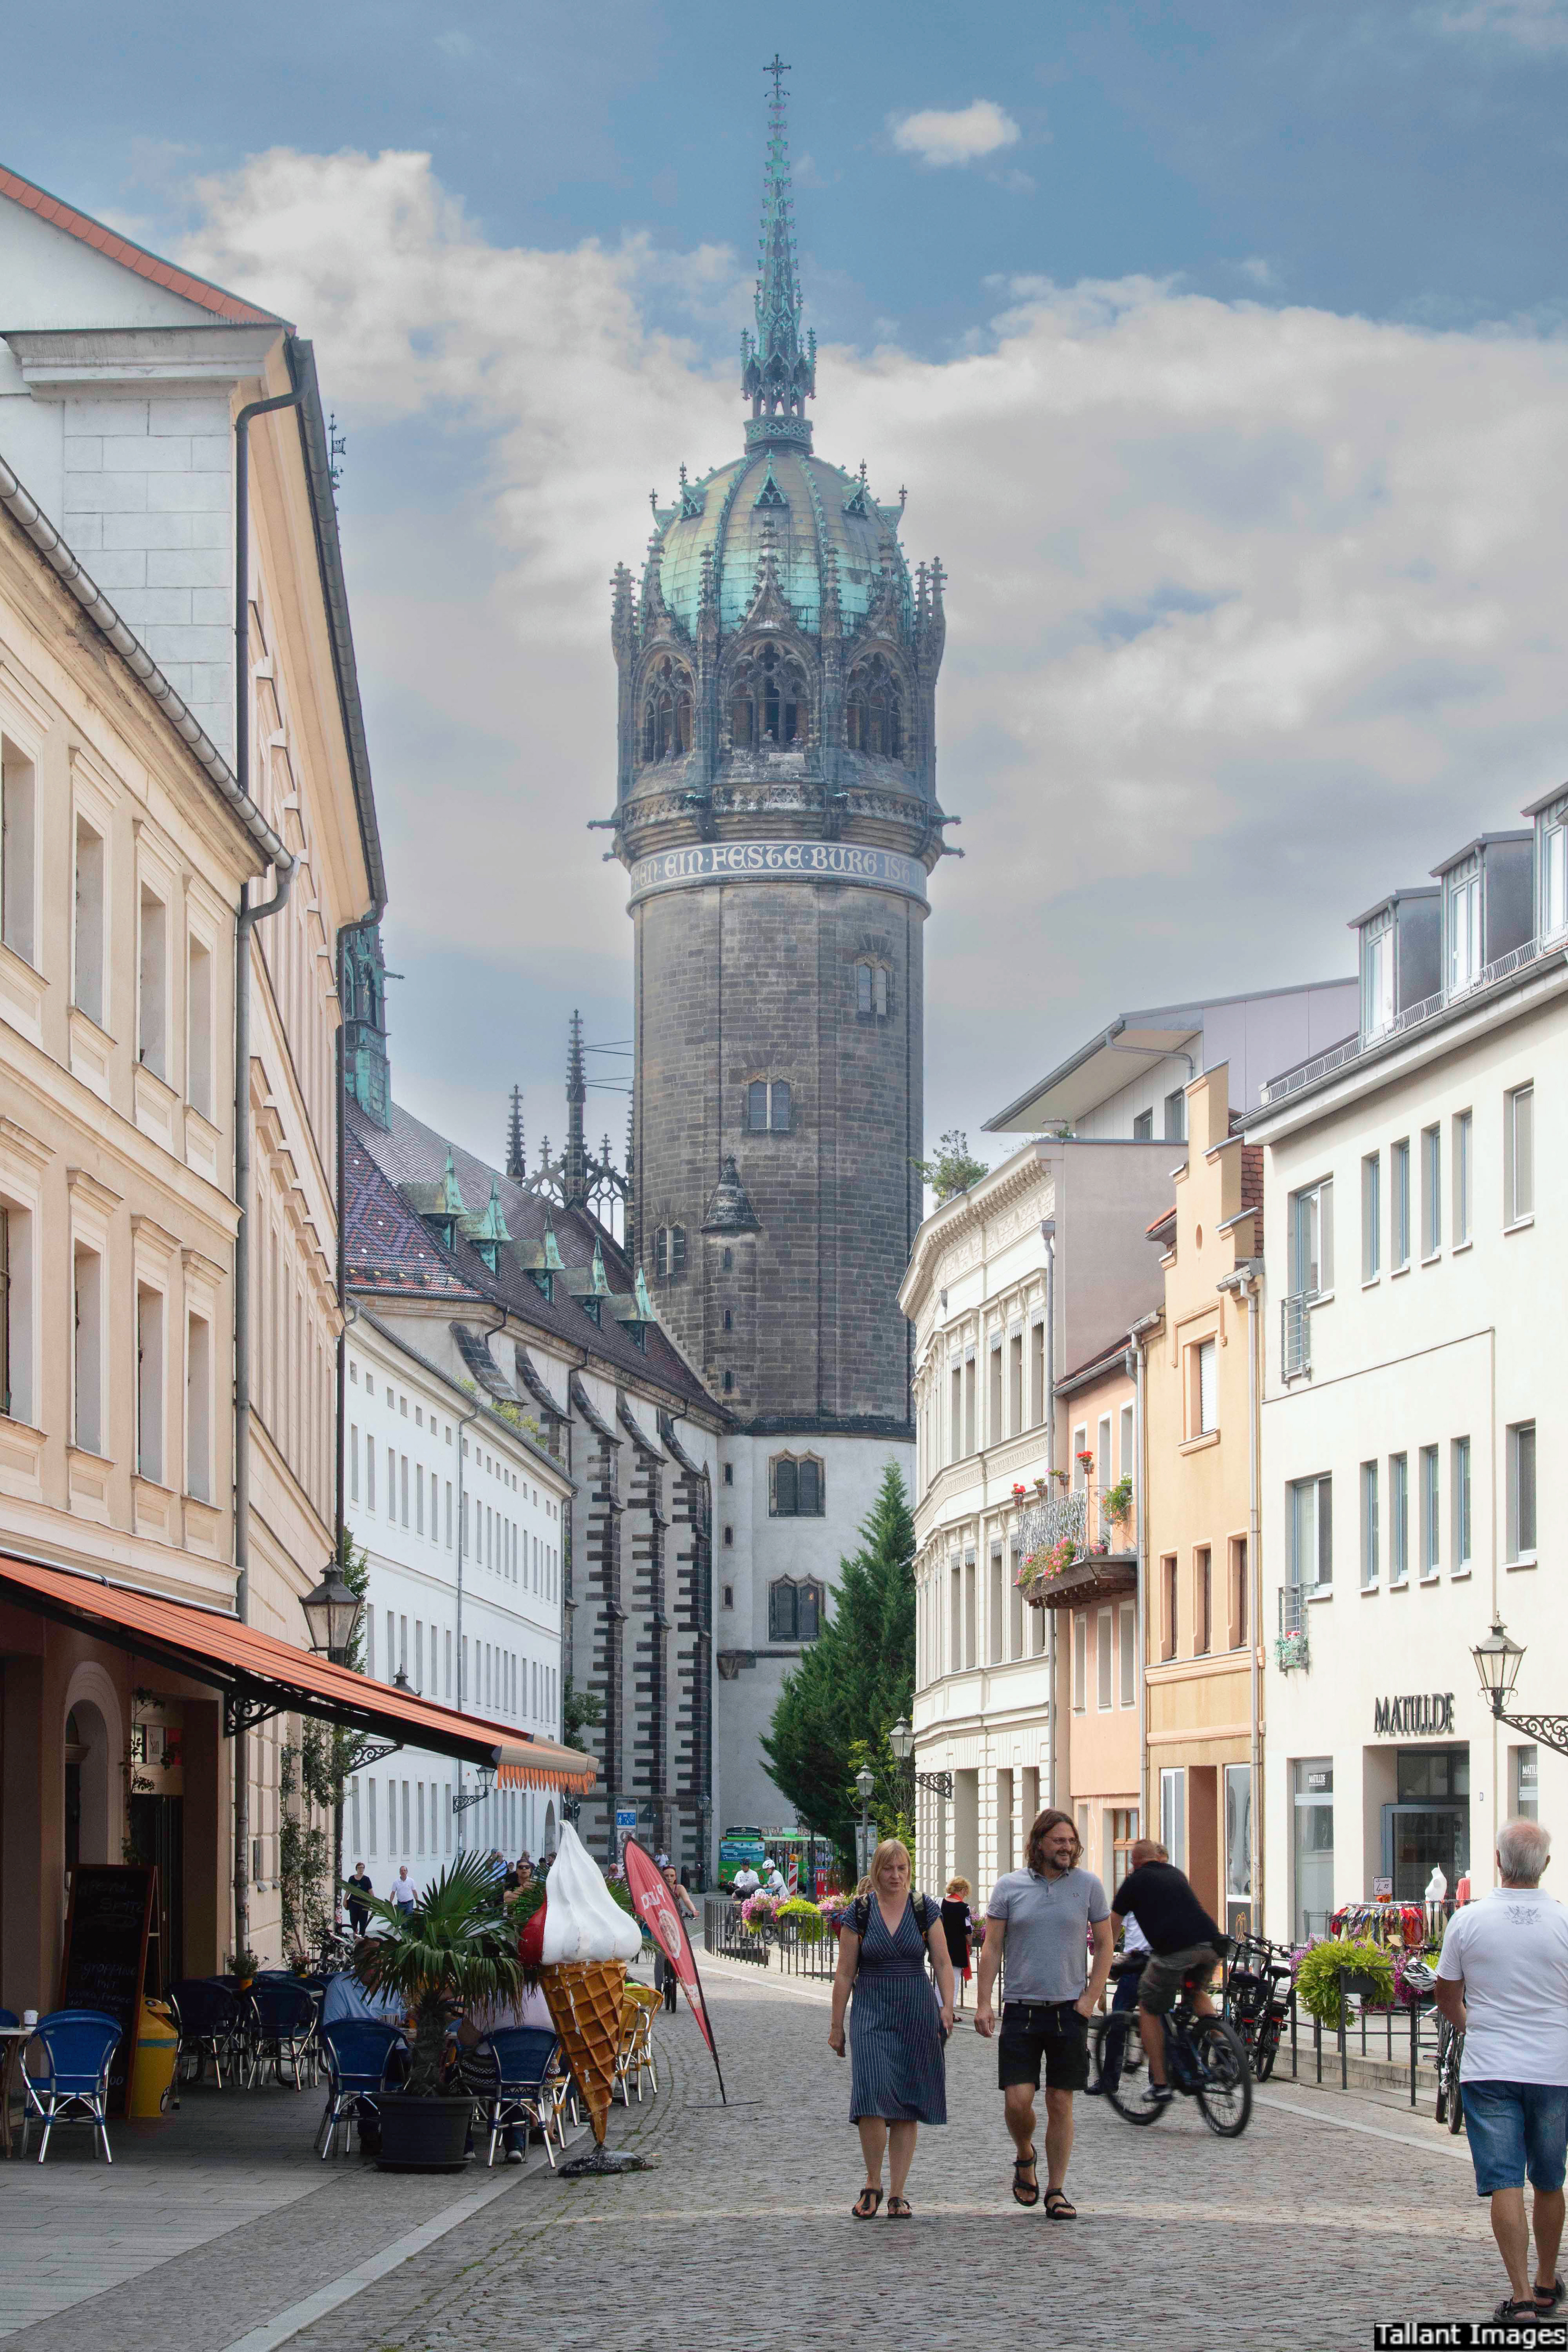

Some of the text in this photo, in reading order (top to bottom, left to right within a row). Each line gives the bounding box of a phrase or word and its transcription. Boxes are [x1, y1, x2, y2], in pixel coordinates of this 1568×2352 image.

[664, 850, 704, 878] EIN
[712, 844, 803, 871] FESTE
[811, 846, 877, 875] BURG
[1373, 1692, 1455, 1733] MATILLDE
